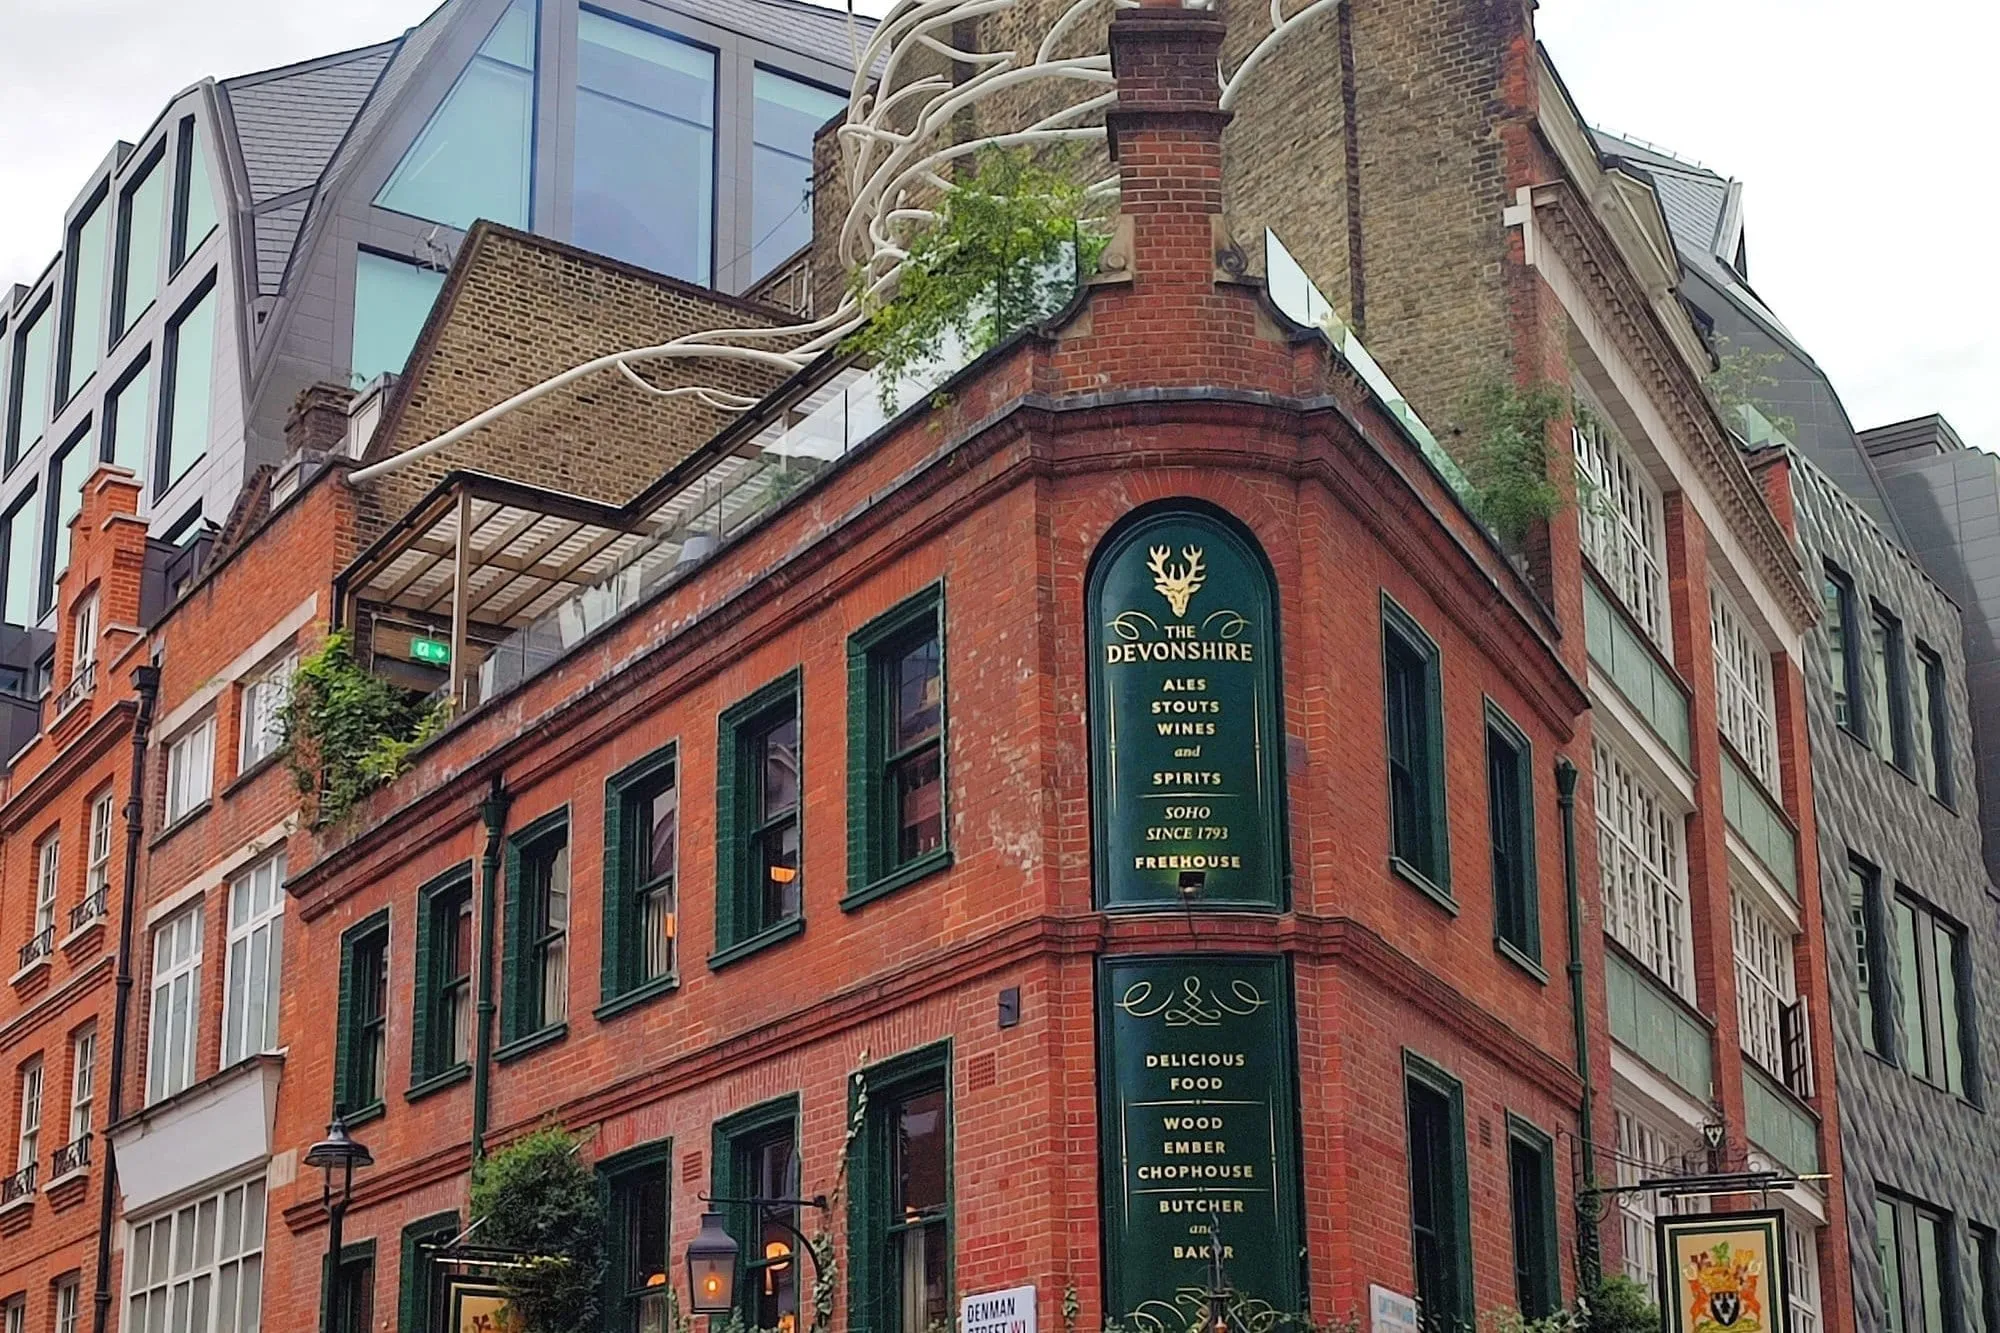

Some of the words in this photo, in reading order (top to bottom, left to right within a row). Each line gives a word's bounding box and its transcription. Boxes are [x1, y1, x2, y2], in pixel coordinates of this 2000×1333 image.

[1163, 625, 1196, 639] THE
[1106, 642, 1253, 664] DEVONSHIRE
[1163, 678, 1206, 692] ALES
[1151, 700, 1219, 714] STOUTS
[1157, 722, 1215, 736] WINES
[1174, 745, 1201, 758] and
[1153, 771, 1221, 786] SPIRITS
[1164, 806, 1211, 820] SOHO
[1146, 827, 1193, 842] SINCE
[1197, 826, 1228, 840] 1793
[1135, 854, 1241, 869] FREEHOUSE
[1146, 1053, 1245, 1068] DELICIOUS
[1170, 1077, 1223, 1091] FOOD
[1163, 1117, 1223, 1130] WOOD
[1164, 1141, 1225, 1154] EMBER
[1137, 1165, 1253, 1179] CHOPHOUSE
[1159, 1199, 1243, 1213] BUTCHER
[1173, 1246, 1233, 1259] BAKR
[967, 1297, 1015, 1323] DENMAN
